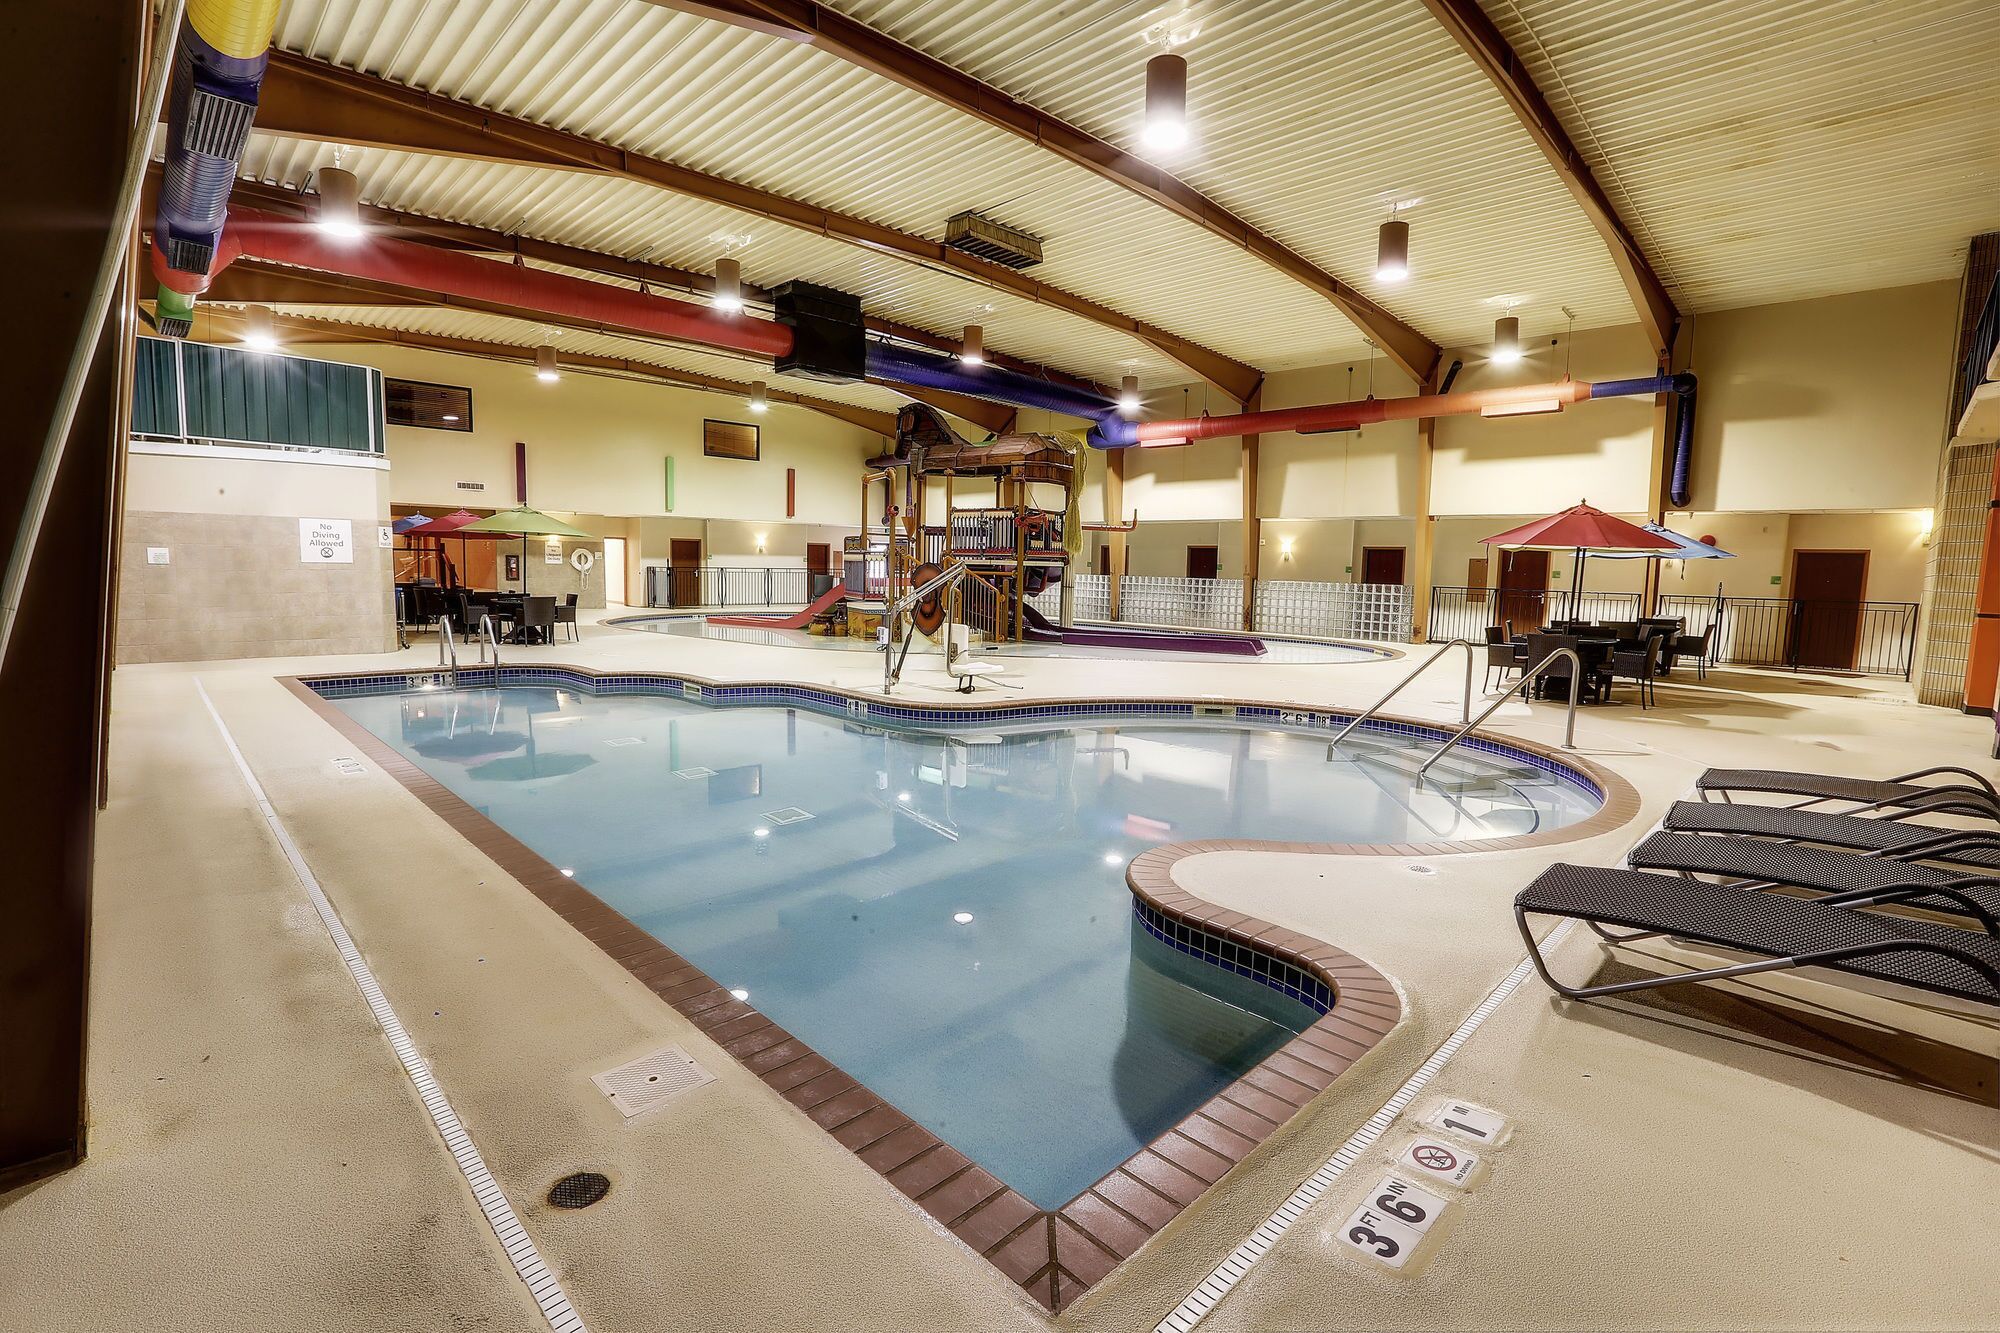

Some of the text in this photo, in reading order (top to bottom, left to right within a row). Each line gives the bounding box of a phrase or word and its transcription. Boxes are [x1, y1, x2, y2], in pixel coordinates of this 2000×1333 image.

[319, 523, 332, 531] No
[309, 539, 344, 547] Allowed
[312, 531, 340, 540] Diving
[1442, 1105, 1488, 1138] 1 M
[1454, 1159, 1474, 1182] NO DIVING
[1348, 1181, 1427, 1259] 3 FT 6 IN
